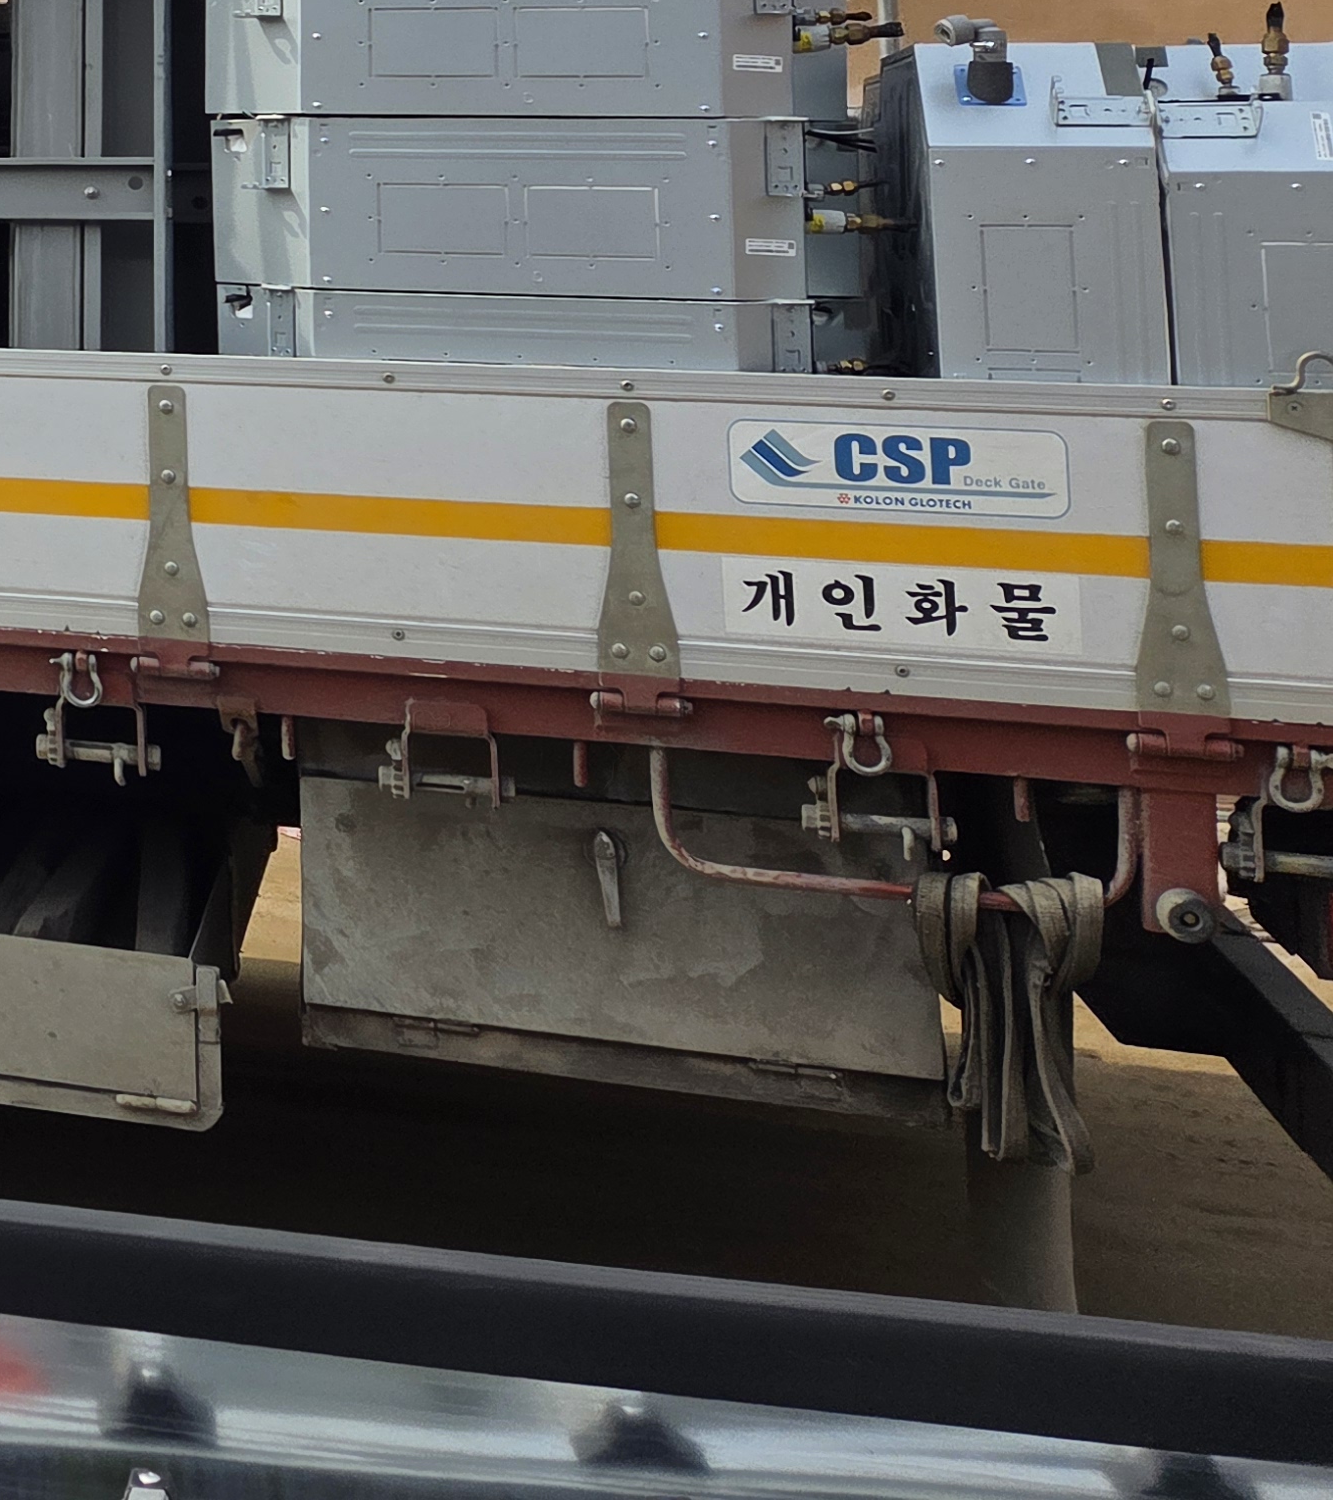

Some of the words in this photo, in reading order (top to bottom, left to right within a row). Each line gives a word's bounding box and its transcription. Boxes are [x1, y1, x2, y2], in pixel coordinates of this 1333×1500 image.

[834, 433, 972, 485] CSP
[963, 475, 1003, 489] Deck
[1009, 478, 1046, 491] Gate
[853, 494, 905, 506] KOLON
[908, 496, 972, 510] GLOTECH
[741, 570, 1057, 642] 개인화물
